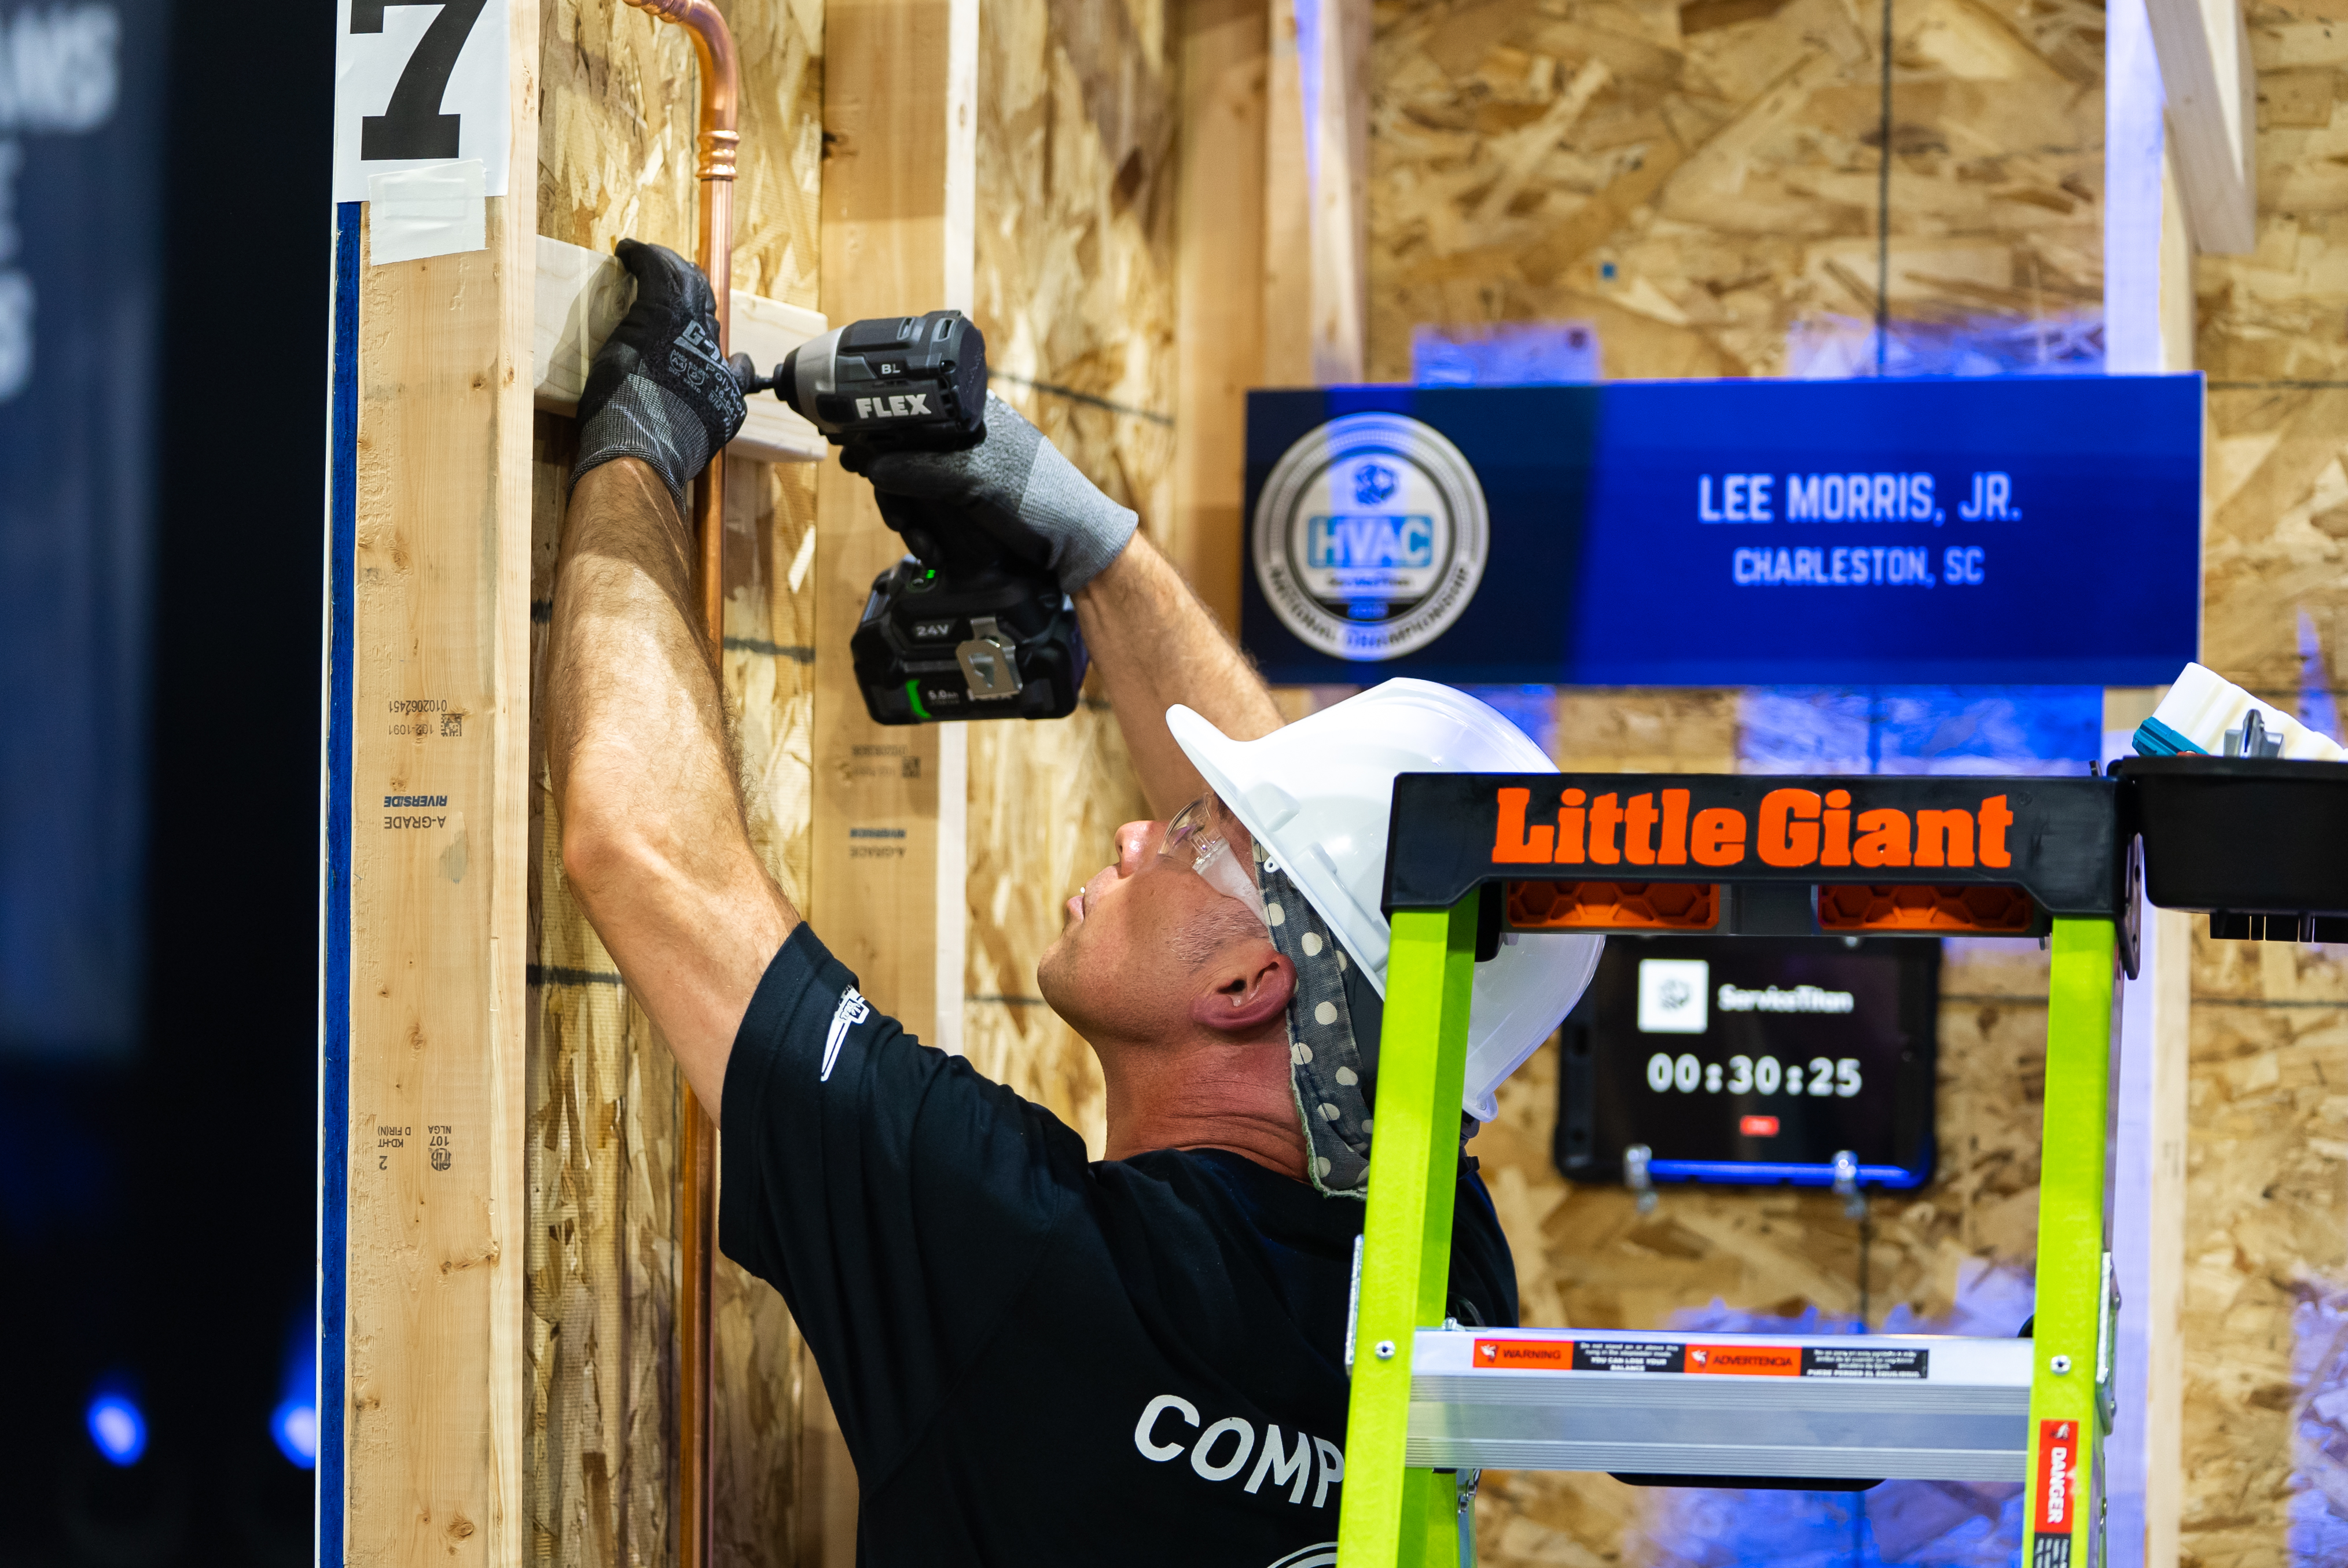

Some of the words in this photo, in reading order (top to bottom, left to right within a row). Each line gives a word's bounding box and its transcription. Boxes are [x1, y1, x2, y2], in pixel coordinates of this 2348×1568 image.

[350, 0, 487, 161] 7
[881, 363, 901, 374] BL
[855, 393, 932, 419] FLEX
[1699, 473, 1774, 523] LEE
[1787, 472, 1946, 527] MORRIS,
[1958, 472, 2022, 522] JR.
[1314, 516, 1432, 567] HVAC
[1734, 546, 1936, 588] CHARLESTON,
[1943, 546, 1984, 586] SC
[915, 624, 950, 637] 24V
[388, 700, 447, 713] 0102062451
[384, 796, 447, 807] RIVERSIDE
[384, 816, 446, 829] A-GRADE
[1491, 787, 1747, 866] Little
[1757, 787, 2013, 869] Giant
[1718, 983, 1854, 1013] ServiceTitan
[1647, 1052, 1862, 1097] 00:30:25
[378, 1125, 402, 1136] FIR(N)
[405, 1127, 411, 1136] D
[428, 1125, 451, 1134] NLGA
[378, 1139, 403, 1147] KD-HT
[429, 1136, 450, 1146] 107
[379, 1155, 388, 1171] 2
[1503, 1349, 1561, 1360] WARNING
[1713, 1355, 1792, 1368] ADVERTENCIA
[1134, 1394, 1344, 1508] COMP
[2047, 1446, 2067, 1524] DANGER
